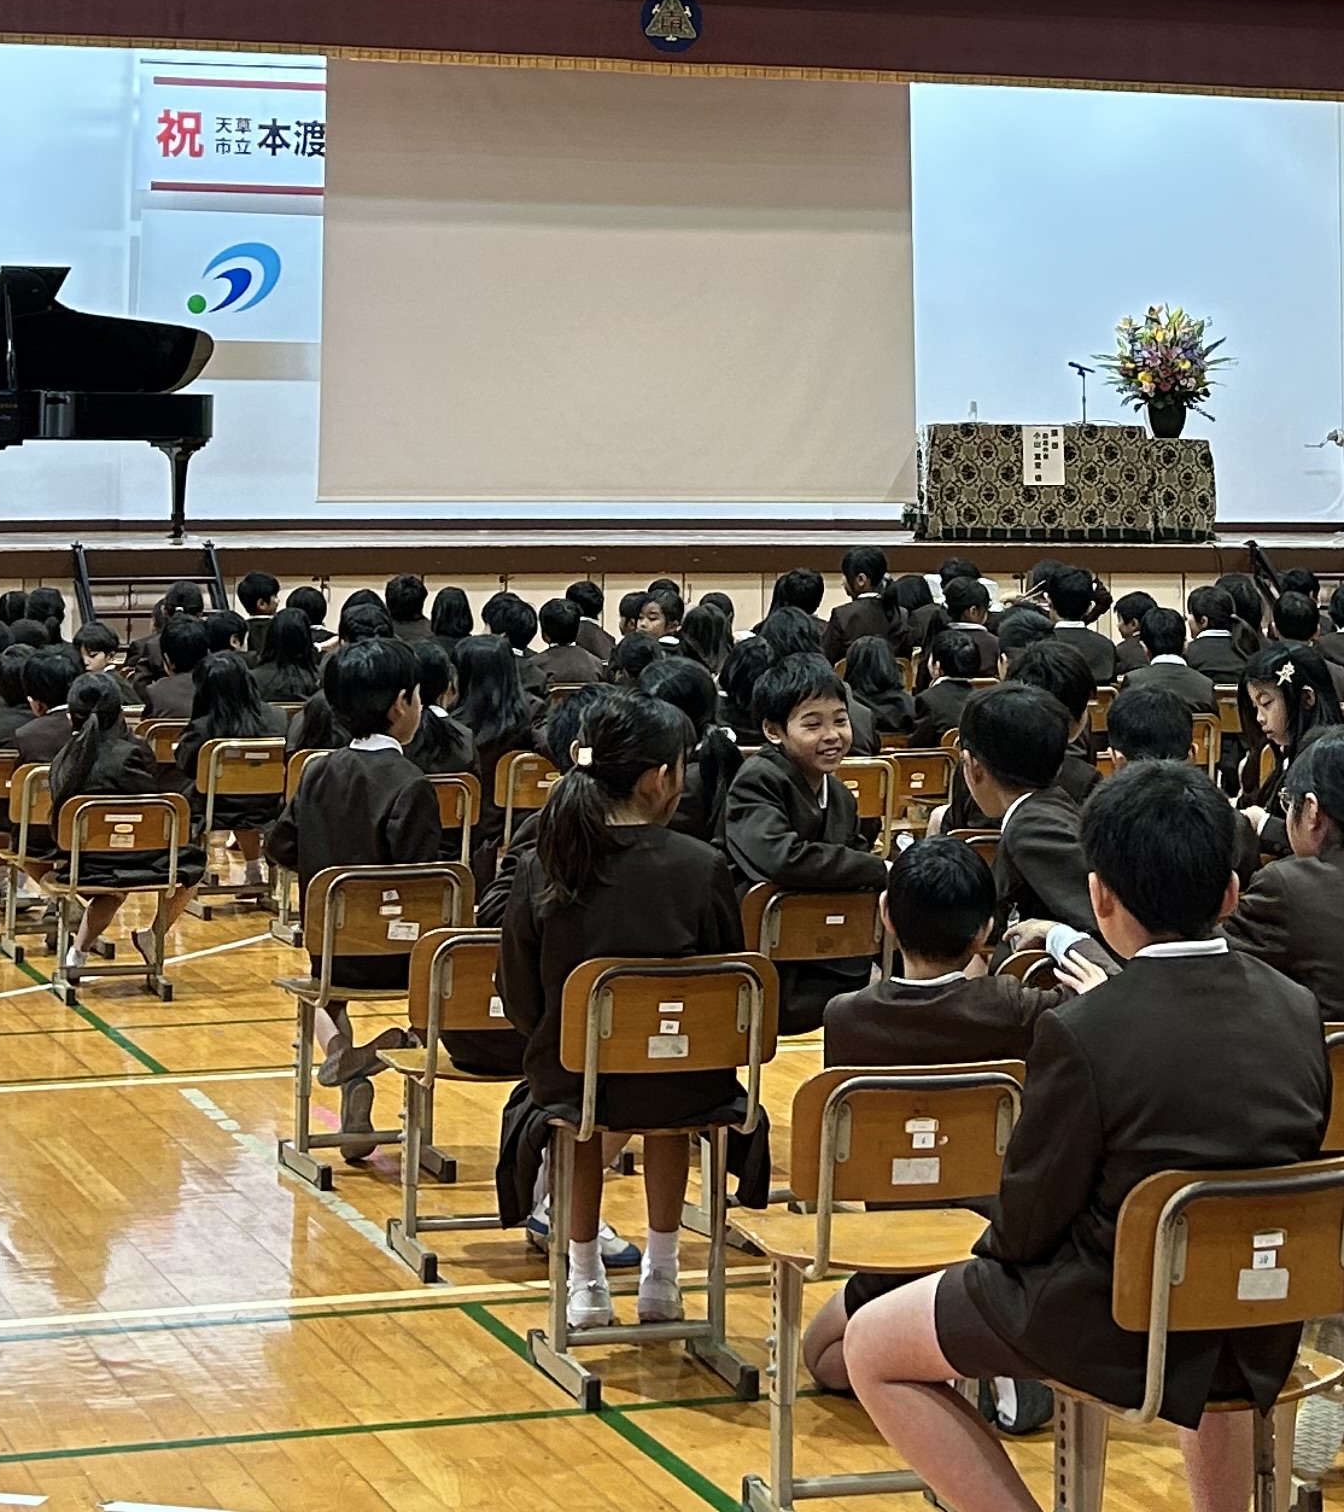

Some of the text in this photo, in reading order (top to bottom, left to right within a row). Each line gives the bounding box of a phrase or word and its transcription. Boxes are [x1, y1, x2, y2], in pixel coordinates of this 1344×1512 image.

[155, 109, 327, 158] 祝 天草 市立 本渡
